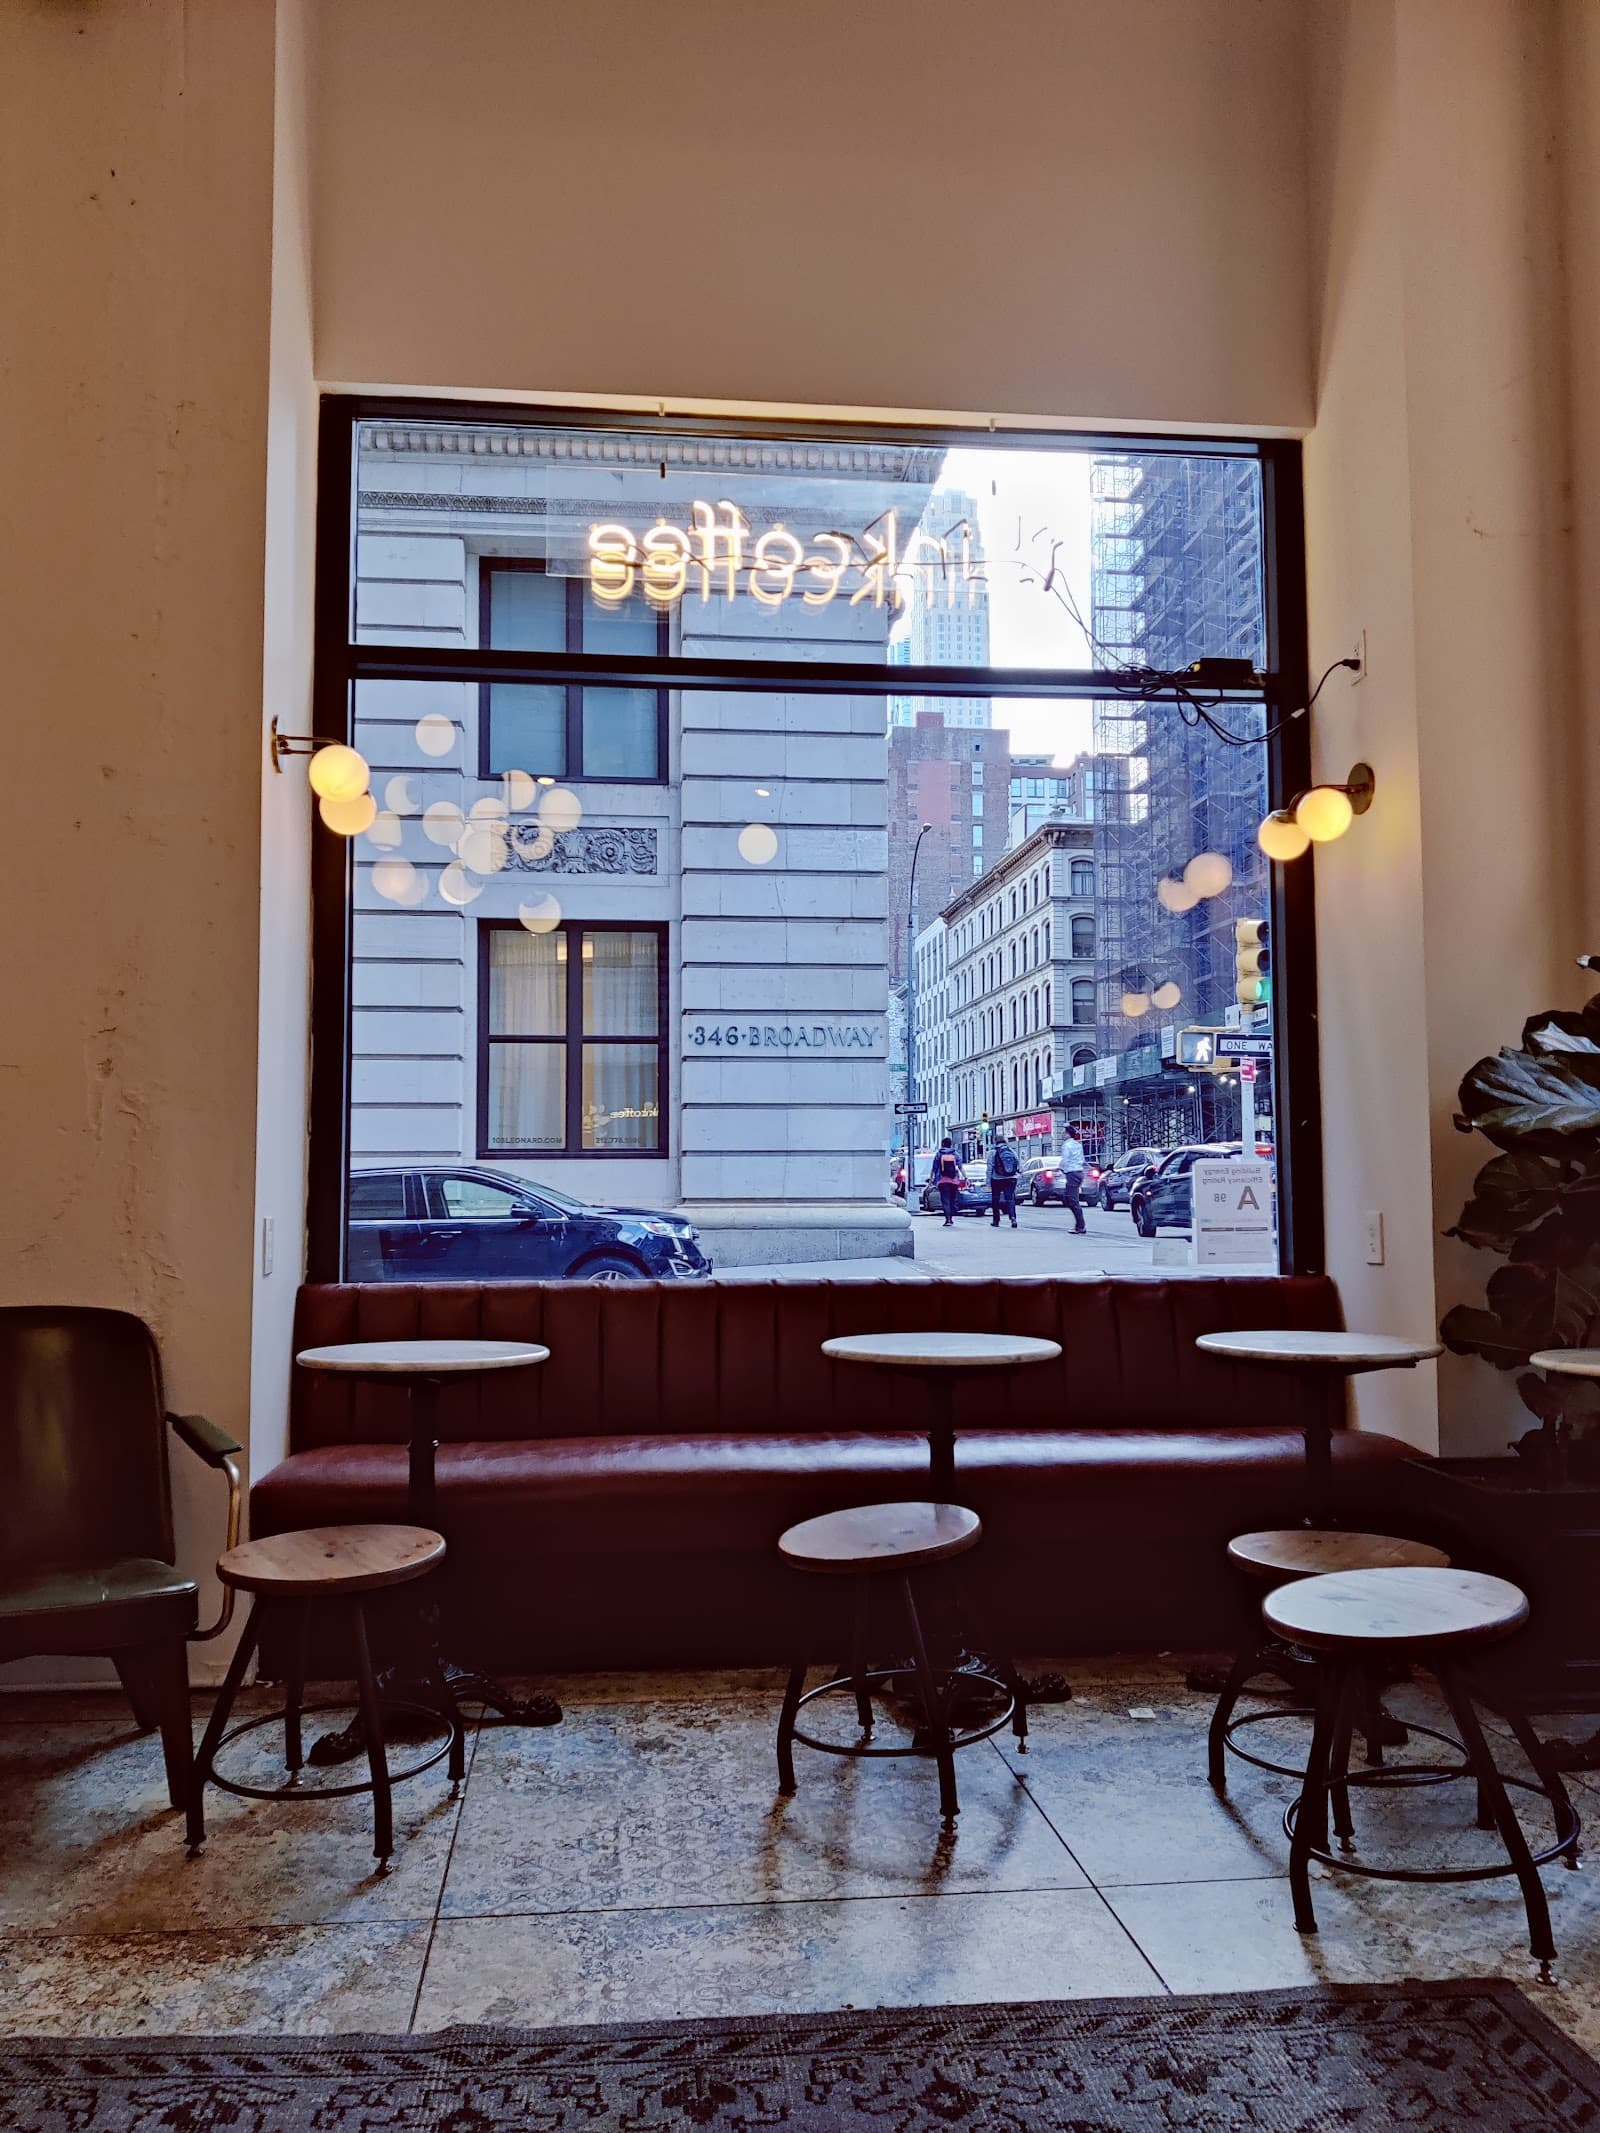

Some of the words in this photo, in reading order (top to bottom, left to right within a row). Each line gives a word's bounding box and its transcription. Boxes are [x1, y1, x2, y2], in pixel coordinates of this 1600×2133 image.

[693, 1025, 739, 1046] 346
[749, 1026, 880, 1047] BROADWAY
[1226, 1040, 1248, 1050] ONE
[1258, 1041, 1272, 1051] WA
